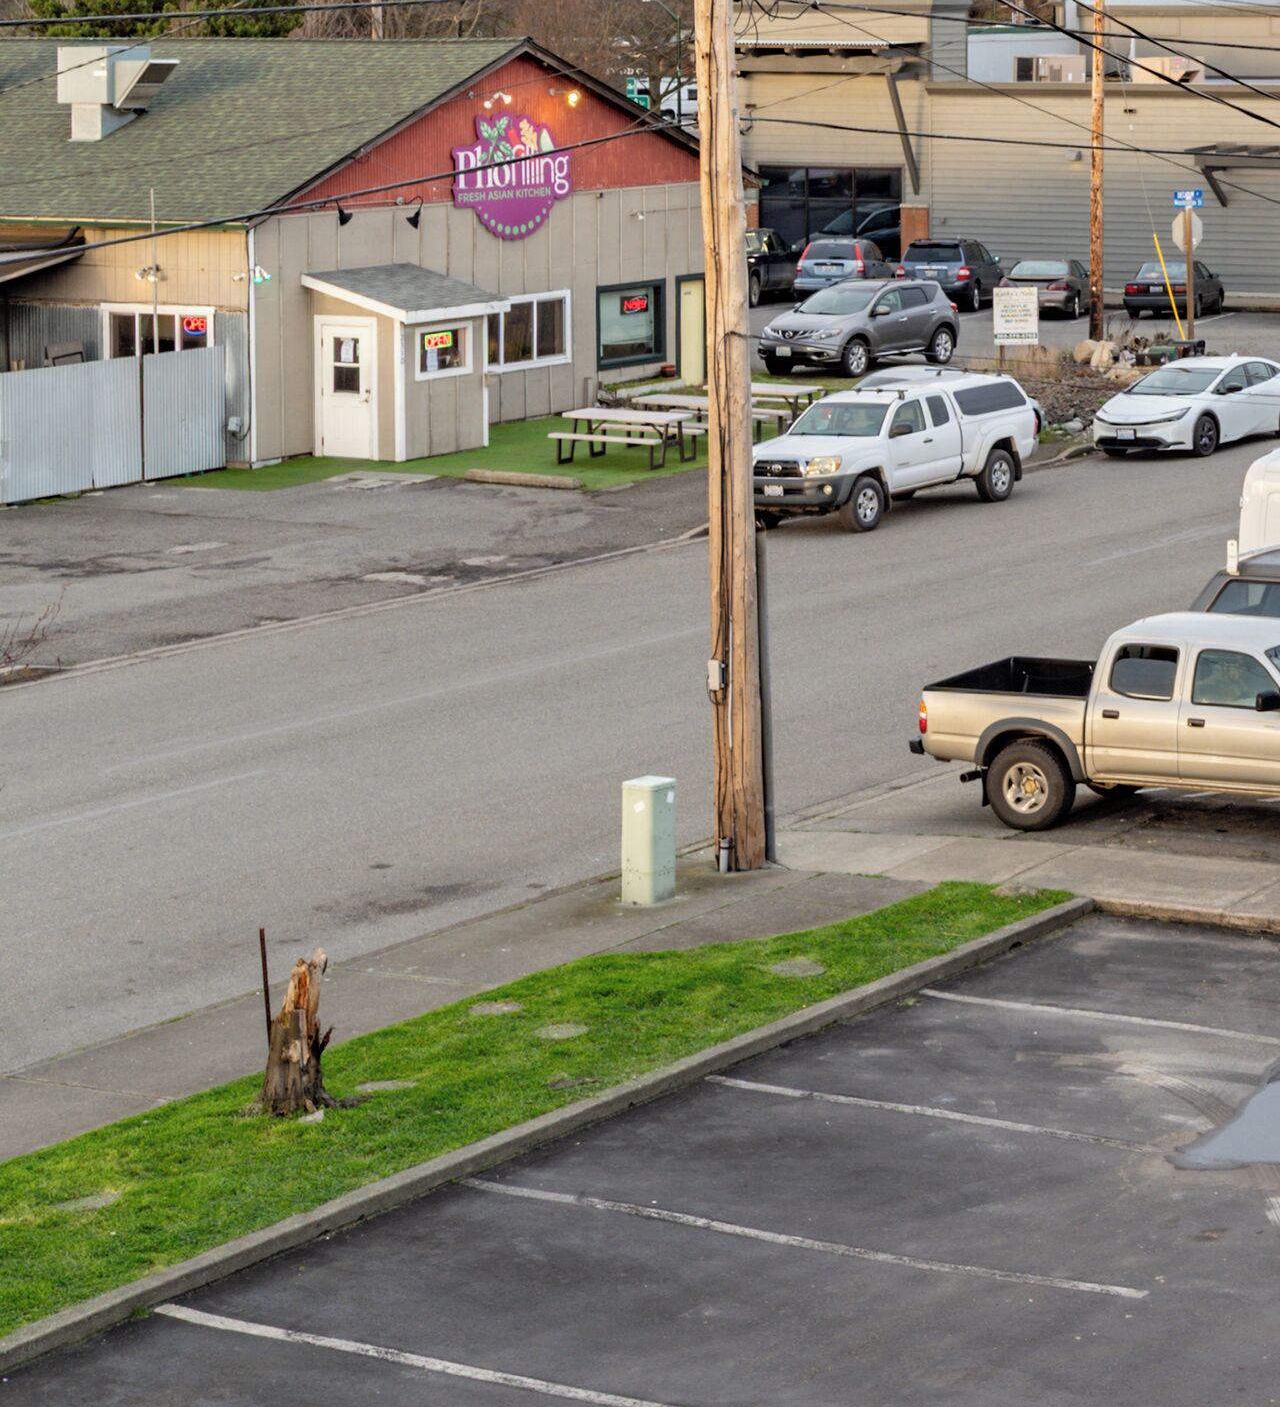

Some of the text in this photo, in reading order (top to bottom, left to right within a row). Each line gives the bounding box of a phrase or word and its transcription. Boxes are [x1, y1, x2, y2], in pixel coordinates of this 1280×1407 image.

[458, 187, 551, 202] FRESH ASIAN KITCHEN
[183, 317, 206, 331] OPE
[426, 333, 451, 348] OPEN
